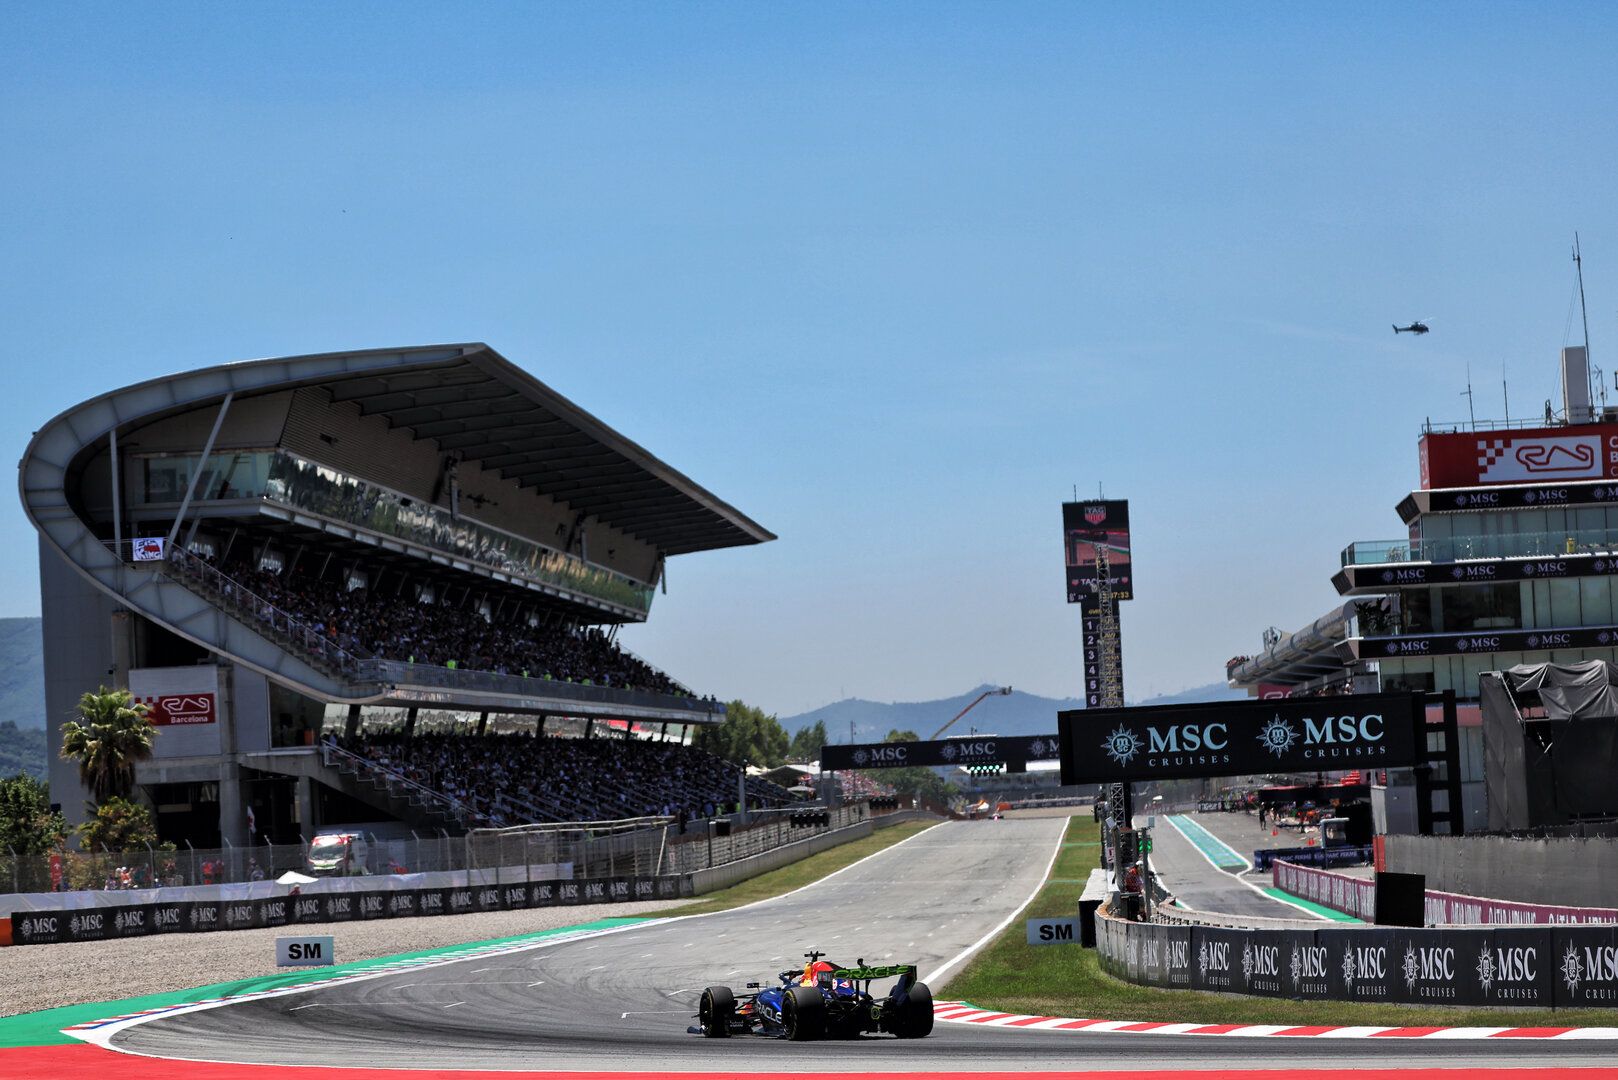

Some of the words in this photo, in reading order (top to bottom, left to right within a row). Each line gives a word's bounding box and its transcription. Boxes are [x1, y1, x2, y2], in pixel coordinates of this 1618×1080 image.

[1470, 492, 1498, 503] MSC
[1539, 489, 1567, 500] MSC
[1467, 566, 1495, 576] MSC
[1538, 562, 1566, 572] MSC
[1397, 569, 1425, 579] MSC
[1088, 621, 1092, 630] 1
[1088, 636, 1093, 644] 2
[1471, 637, 1500, 648] MSC
[1542, 634, 1570, 644] MSC
[1401, 641, 1429, 651] MSC
[1089, 651, 1095, 659] 3
[1089, 666, 1095, 674] 4
[1090, 680, 1096, 689] 5
[1091, 696, 1096, 704] 6
[1302, 715, 1384, 744] MSC
[1147, 723, 1228, 753] MSC
[872, 747, 907, 761] MSC
[960, 742, 996, 756] MSC
[1304, 746, 1386, 758] CRUISES
[1149, 755, 1229, 766] CRUISES
[302, 900, 319, 914] MSC
[335, 898, 351, 912] MSC
[367, 897, 383, 911] MSC
[397, 896, 412, 908] MSC
[427, 894, 442, 907] MSC
[162, 908, 179, 923] MSC
[199, 908, 217, 922] MSC
[235, 906, 252, 920] MSC
[268, 902, 286, 918] MSC
[81, 915, 103, 930] MSC
[124, 911, 144, 926] MSC
[33, 918, 57, 933] MSC
[1040, 924, 1072, 940] SM
[288, 944, 321, 960] SM
[1172, 941, 1188, 968] MSC
[1209, 942, 1229, 970] MSC
[1254, 945, 1278, 976] MSC
[1302, 946, 1327, 977] MSC
[1357, 947, 1386, 979] MSC
[1420, 947, 1455, 980] MSC
[1497, 947, 1536, 981] MSC
[1209, 976, 1230, 986] CRUISES
[1254, 980, 1279, 991] CRUISES
[1302, 984, 1327, 993] CRUISES
[1357, 986, 1386, 995] CRUISES
[1420, 987, 1456, 998] CRUISES
[1497, 988, 1538, 999] CRUISES
[757, 999, 782, 1024] RACLE
